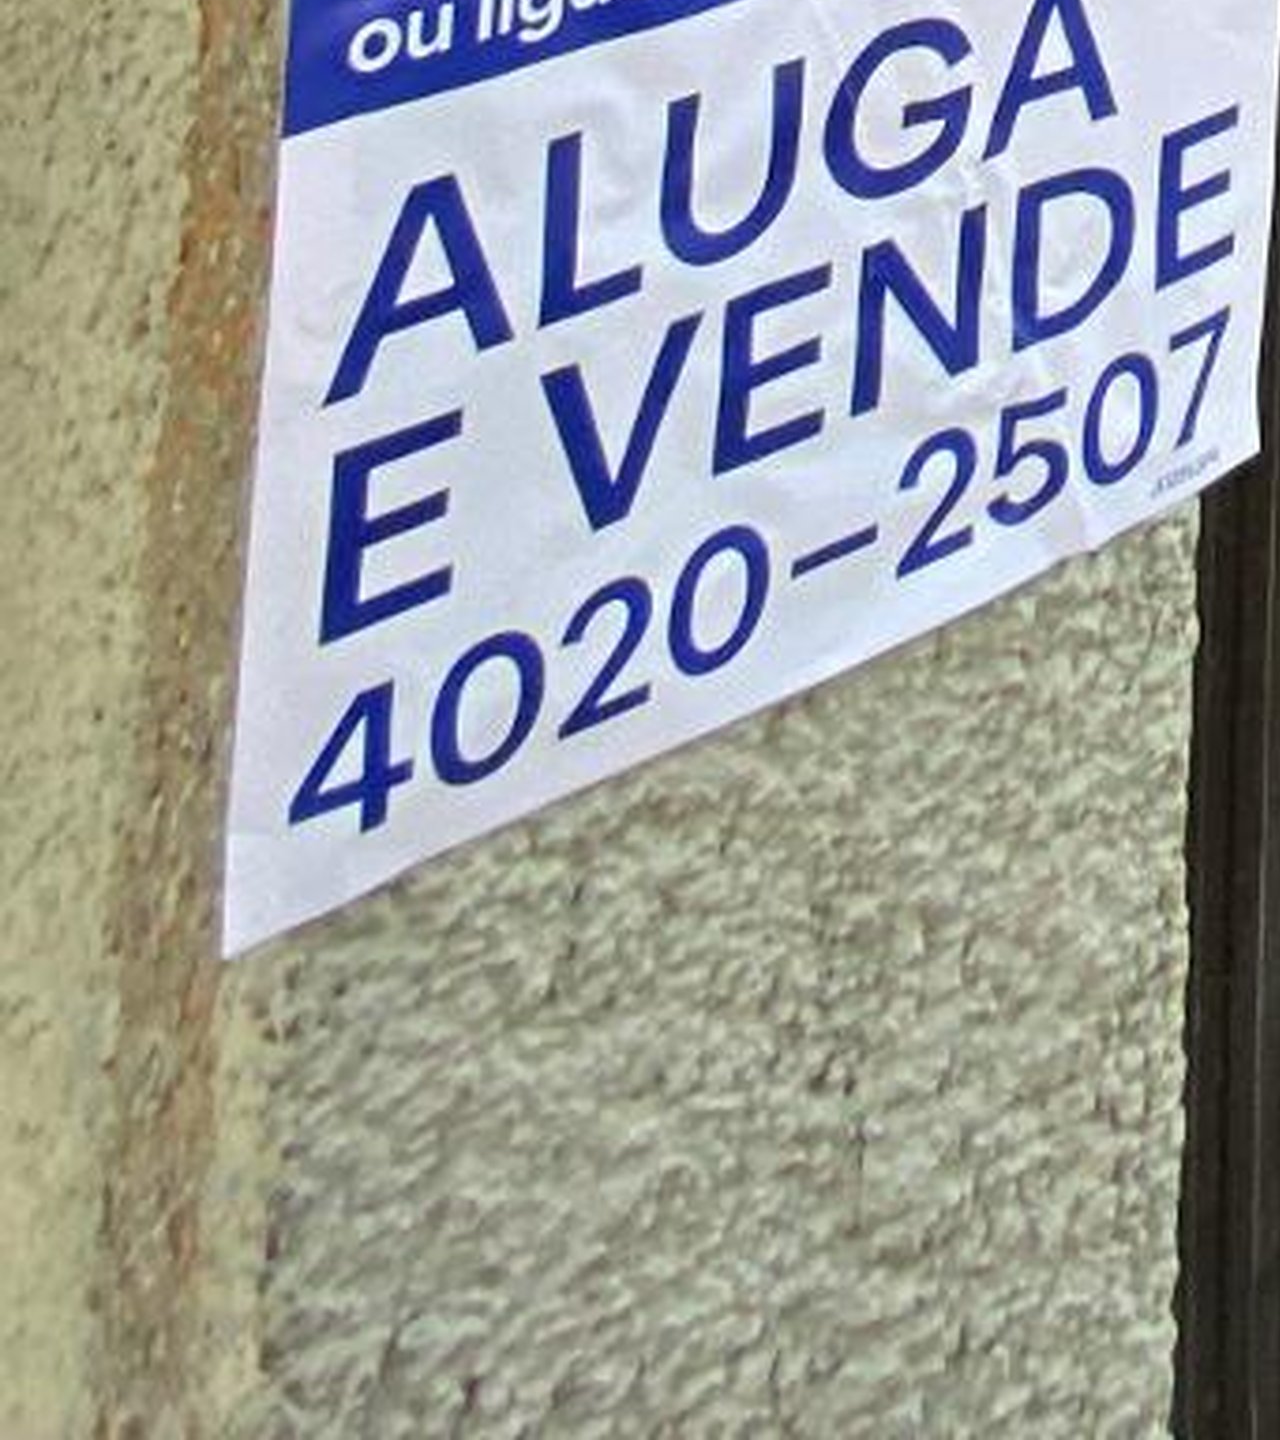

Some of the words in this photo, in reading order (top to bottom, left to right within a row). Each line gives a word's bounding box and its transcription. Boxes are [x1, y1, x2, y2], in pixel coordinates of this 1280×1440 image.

[347, 1, 455, 74] ou
[286, 305, 1231, 833] 4020-2507
[318, 408, 464, 647] E
[539, 105, 1240, 533] VENDE
